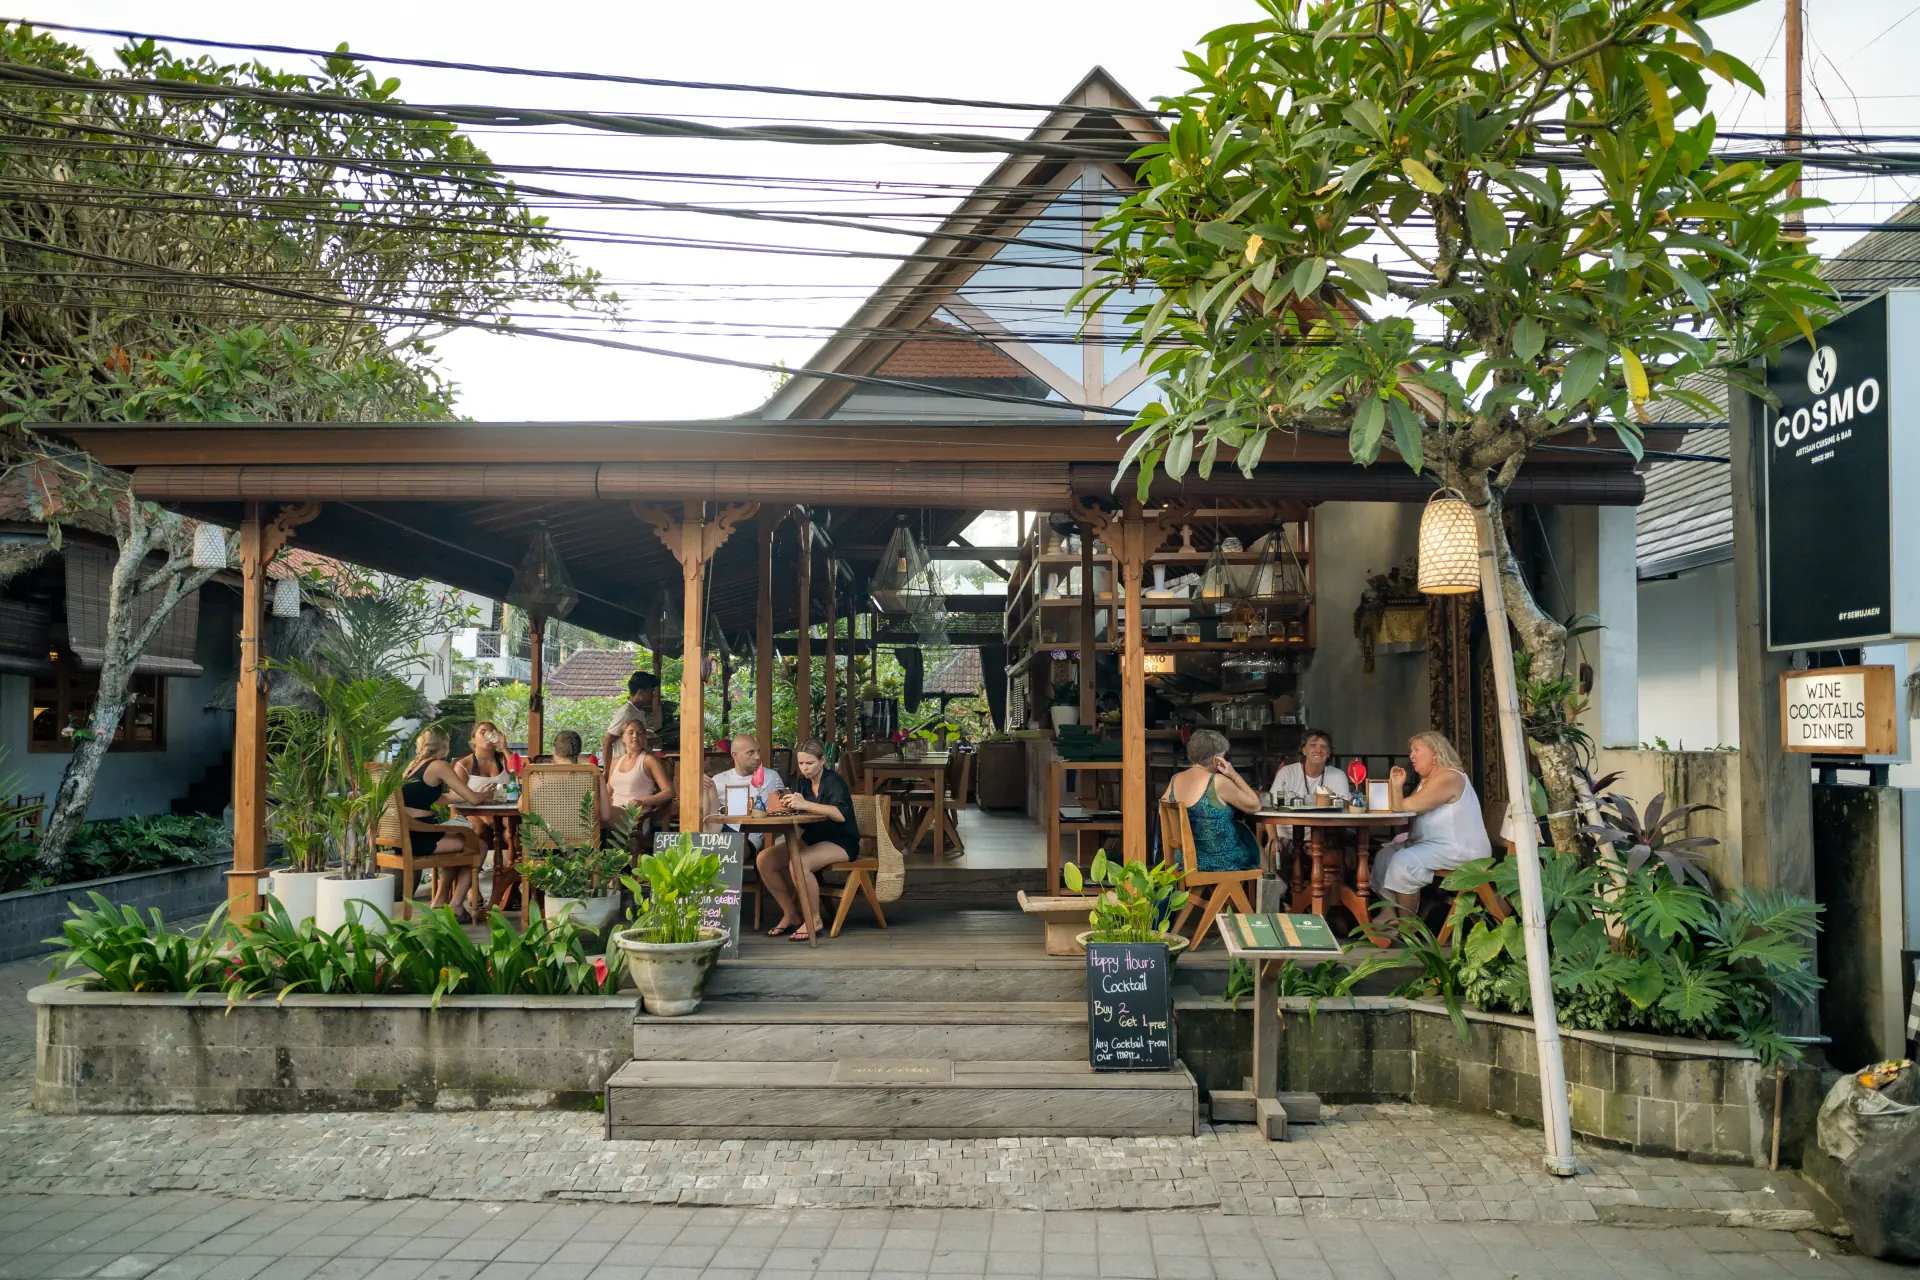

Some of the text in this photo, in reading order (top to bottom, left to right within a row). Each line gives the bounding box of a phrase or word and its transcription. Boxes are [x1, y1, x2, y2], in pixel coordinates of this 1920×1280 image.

[1774, 377, 1880, 448] COSMO
[1795, 443, 1816, 457] ARTISAN
[1816, 435, 1836, 449] CUISINE
[1841, 428, 1852, 440] BAR
[1811, 454, 1824, 464] SINCE
[1838, 612, 1848, 621] BY
[1806, 682, 1842, 699] WINE
[1789, 702, 1865, 719] COCKTAILS
[1803, 723, 1854, 740] DINNER
[700, 833, 732, 850] TODAY
[1091, 949, 1119, 974] Happy
[1102, 972, 1147, 993] Cocktail
[1094, 1000, 1130, 1022] Buy 2
[1118, 1014, 1138, 1027] Get
[1142, 1013, 1148, 1027] 1
[1095, 1037, 1109, 1053] Any
[1111, 1035, 1144, 1050] Cocktail
